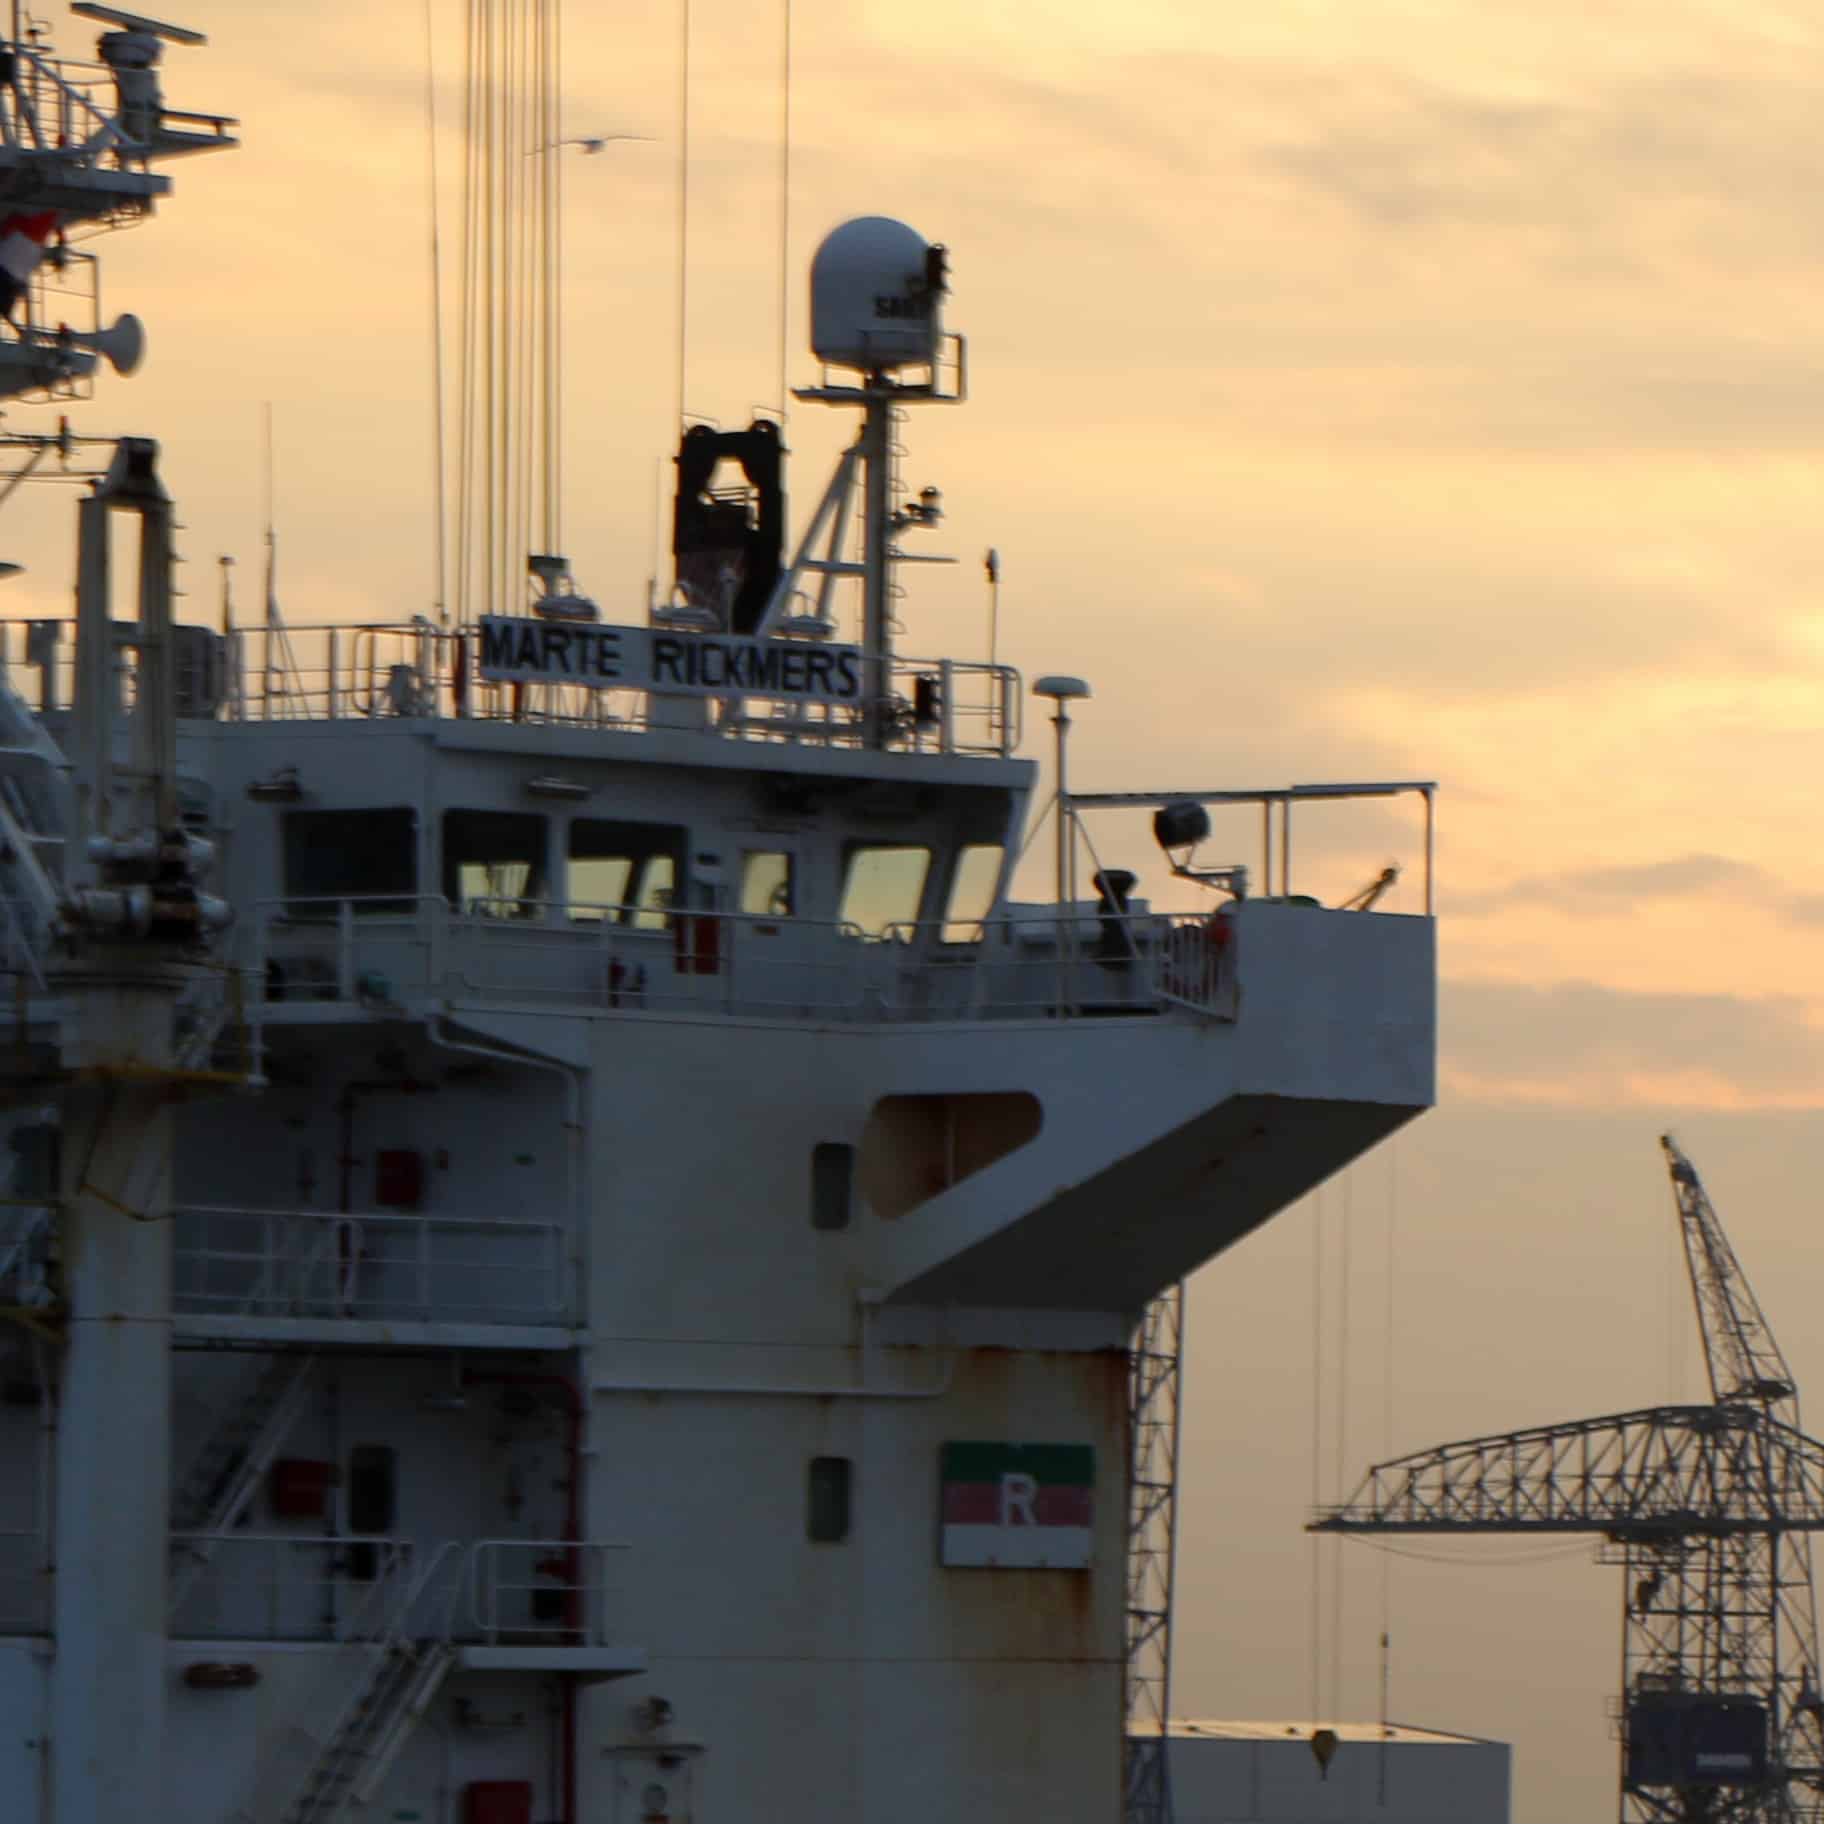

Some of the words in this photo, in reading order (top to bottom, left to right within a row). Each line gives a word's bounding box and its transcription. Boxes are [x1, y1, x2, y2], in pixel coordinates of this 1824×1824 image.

[481, 619, 621, 678] MARTE
[651, 638, 859, 699] RICKMERS
[1001, 1472, 1038, 1531] R
